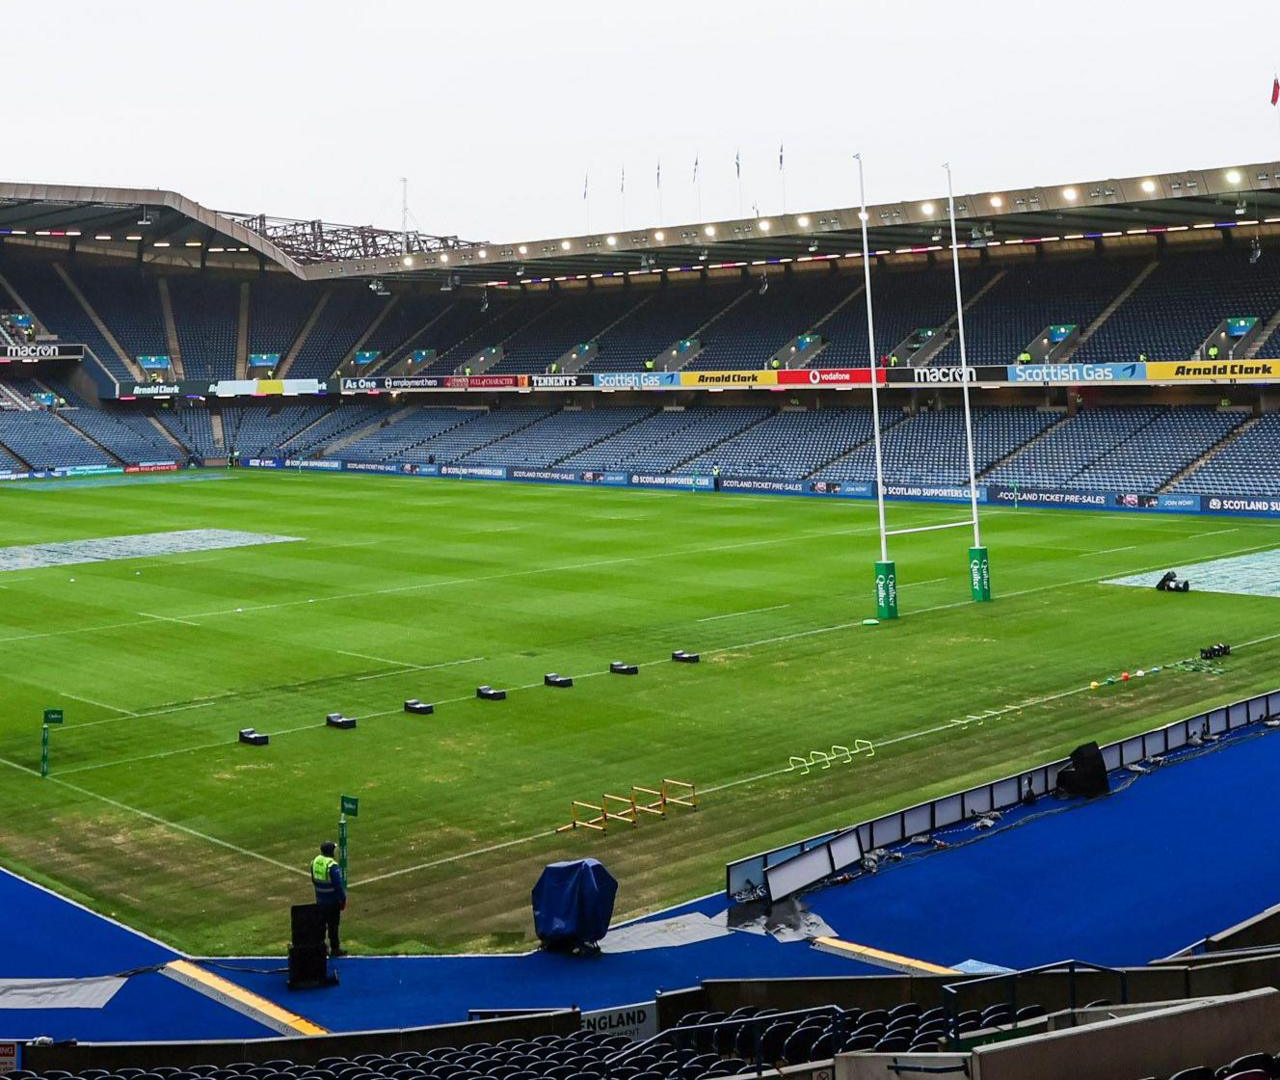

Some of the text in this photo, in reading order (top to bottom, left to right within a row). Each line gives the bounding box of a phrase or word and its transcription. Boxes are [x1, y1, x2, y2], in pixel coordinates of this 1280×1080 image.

[7, 345, 59, 356] macron
[914, 367, 976, 382] macron
[1016, 364, 1113, 381] Scottish Gas
[1175, 364, 1272, 376] Arnold Clark
[598, 374, 660, 387] Scottish Gas
[698, 374, 758, 383] Arnold Clark
[821, 372, 850, 381] vodafone
[345, 380, 376, 389] As One
[640, 476, 665, 484] SCOTLAND
[723, 480, 802, 491] SCOTLAND TICKET PRE-SALES
[888, 486, 980, 498] SCOTLAND SUPPORTERS CLB
[1039, 493, 1063, 502] TICKET
[1065, 495, 1105, 504] PRE-SALES
[1223, 499, 1268, 511] SCOTLAND
[971, 560, 980, 591] Quilter
[876, 574, 886, 608] Quilter
[887, 574, 896, 606] Quilter
[580, 1009, 647, 1031] ENGLAND
